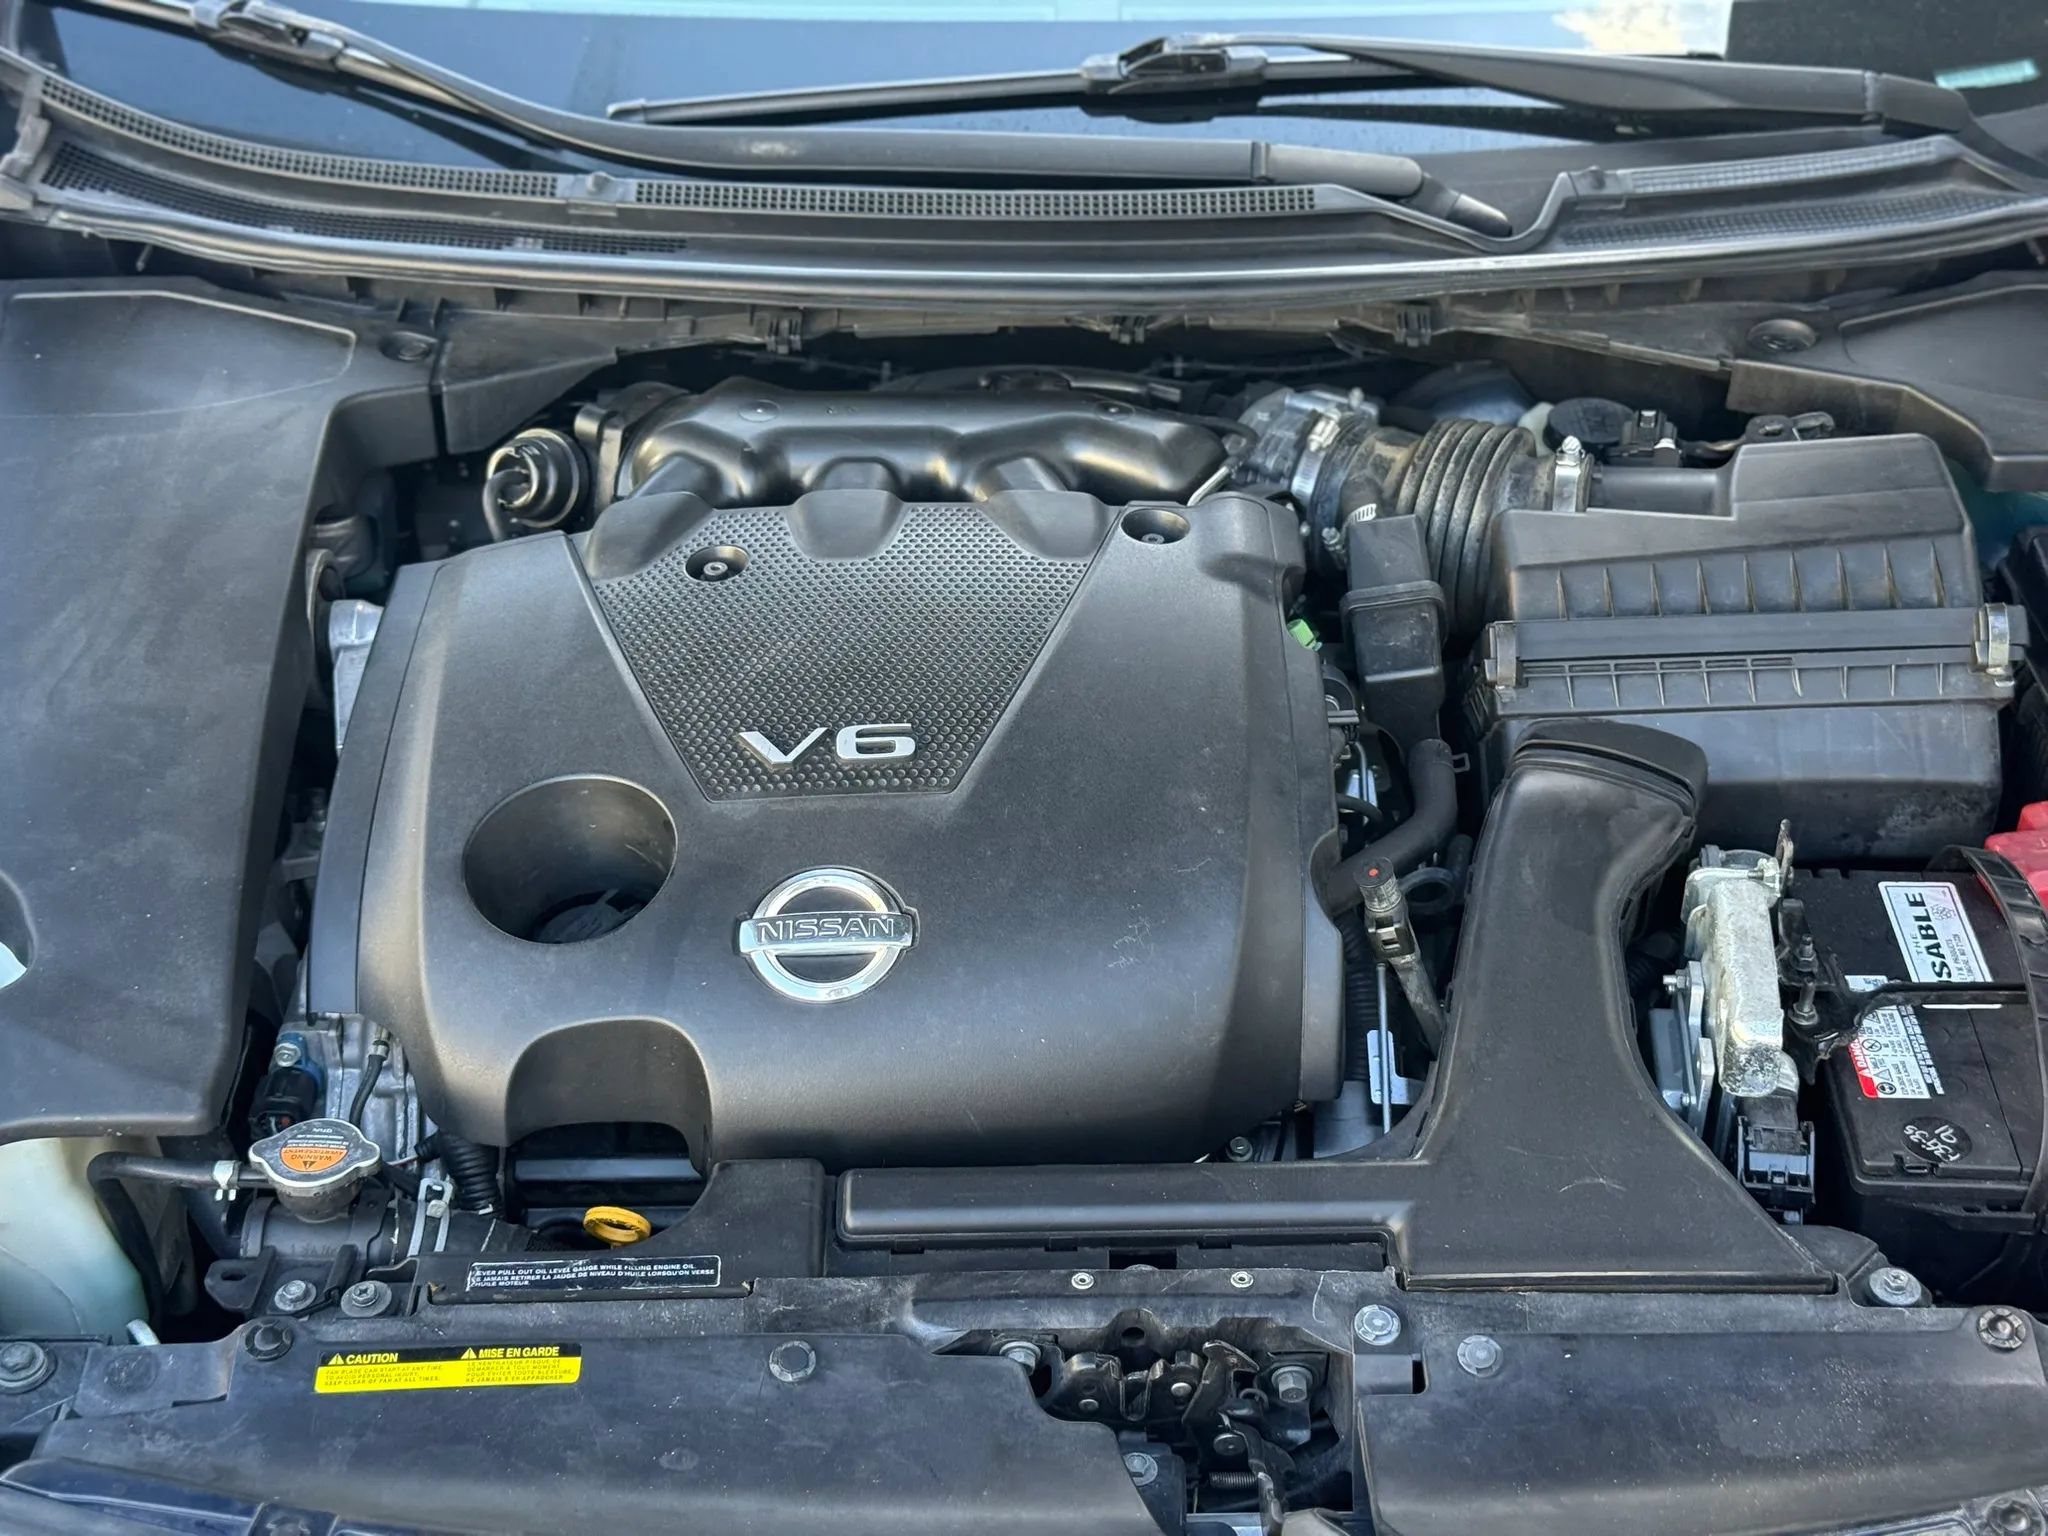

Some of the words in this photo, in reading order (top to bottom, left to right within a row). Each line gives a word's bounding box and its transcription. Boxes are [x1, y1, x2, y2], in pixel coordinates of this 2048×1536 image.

[738, 722, 917, 767] V6
[756, 916, 895, 943] NISSAN
[1904, 892, 1953, 982] SABLE
[1910, 933, 1924, 955] THE
[1849, 1038, 1867, 1068] DANG
[572, 1264, 599, 1273] GAUGE
[345, 1352, 399, 1365] CAUTION
[478, 1348, 505, 1359] MISE
[506, 1347, 522, 1358] EN
[522, 1346, 560, 1357] GARDE
